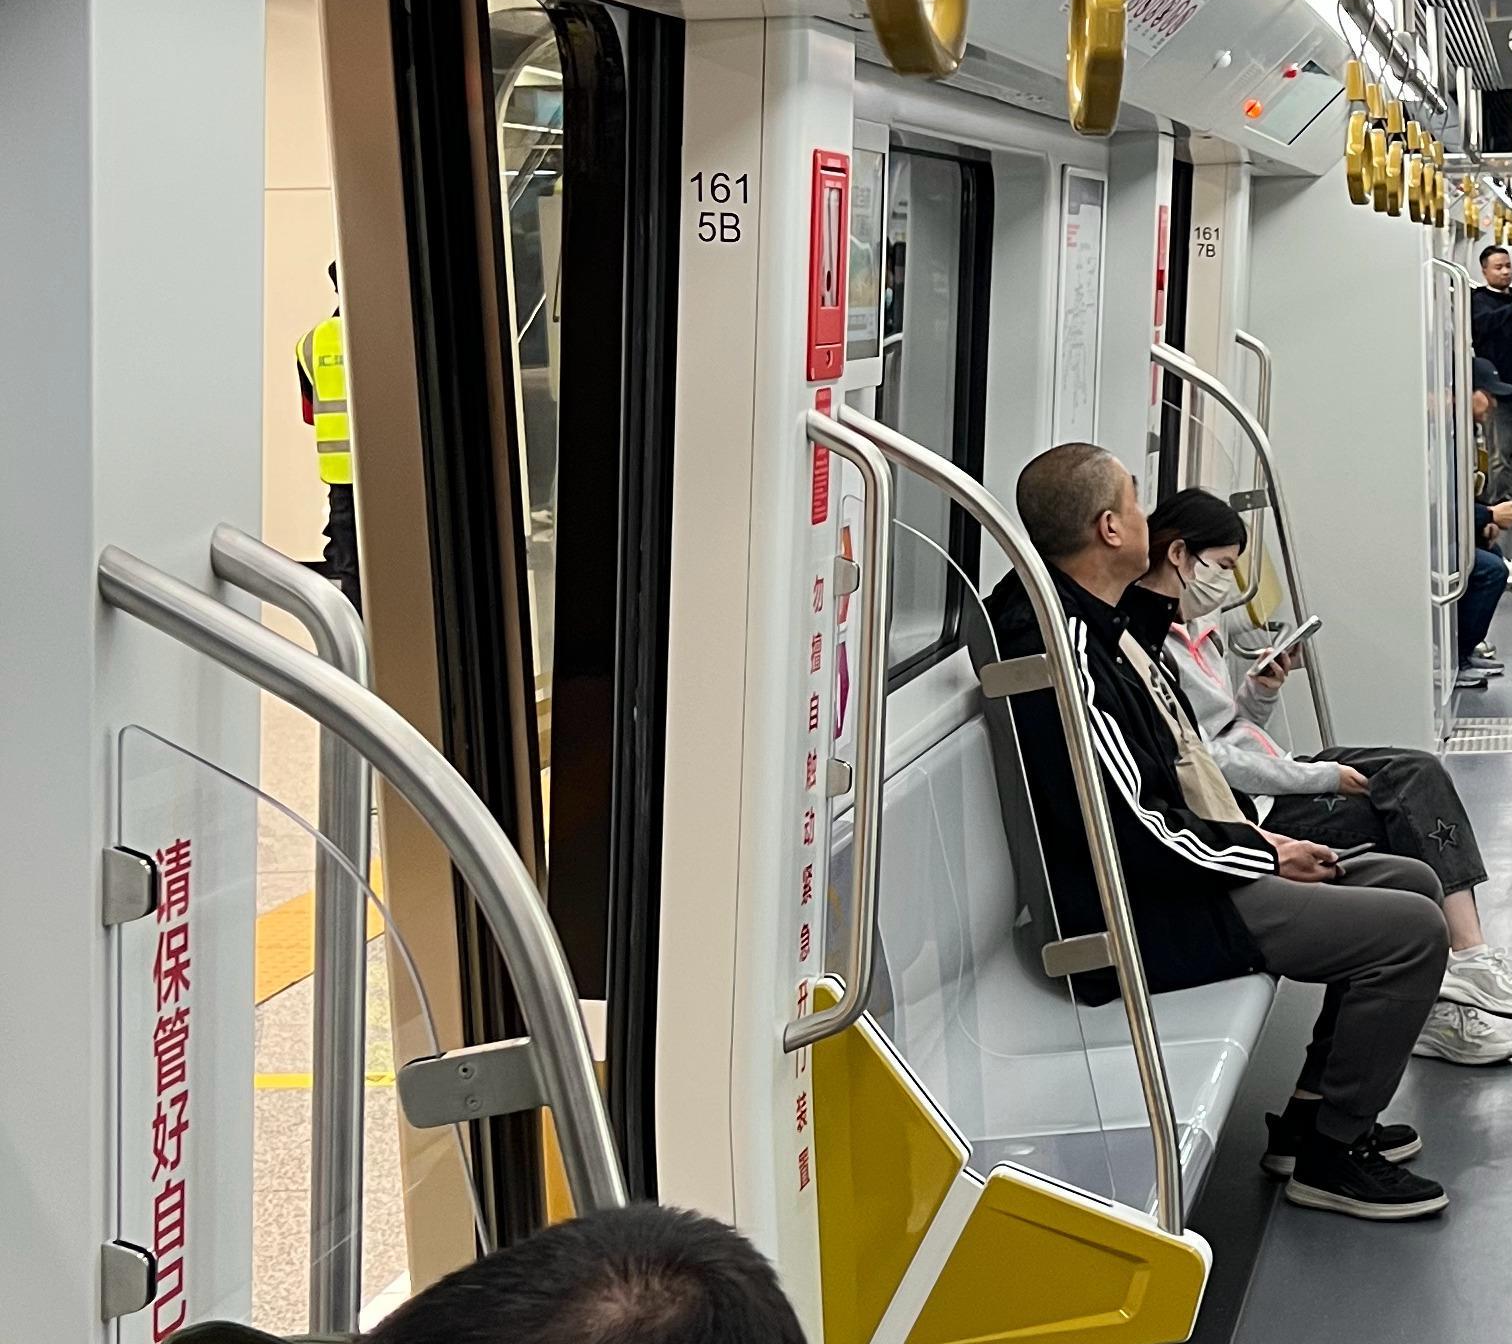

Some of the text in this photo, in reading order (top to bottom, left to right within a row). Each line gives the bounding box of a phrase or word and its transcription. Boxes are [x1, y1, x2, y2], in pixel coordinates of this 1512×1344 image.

[690, 172, 748, 204] 161
[698, 212, 741, 242] 5B
[1194, 226, 1221, 241] 161
[1196, 243, 1217, 258] 7B
